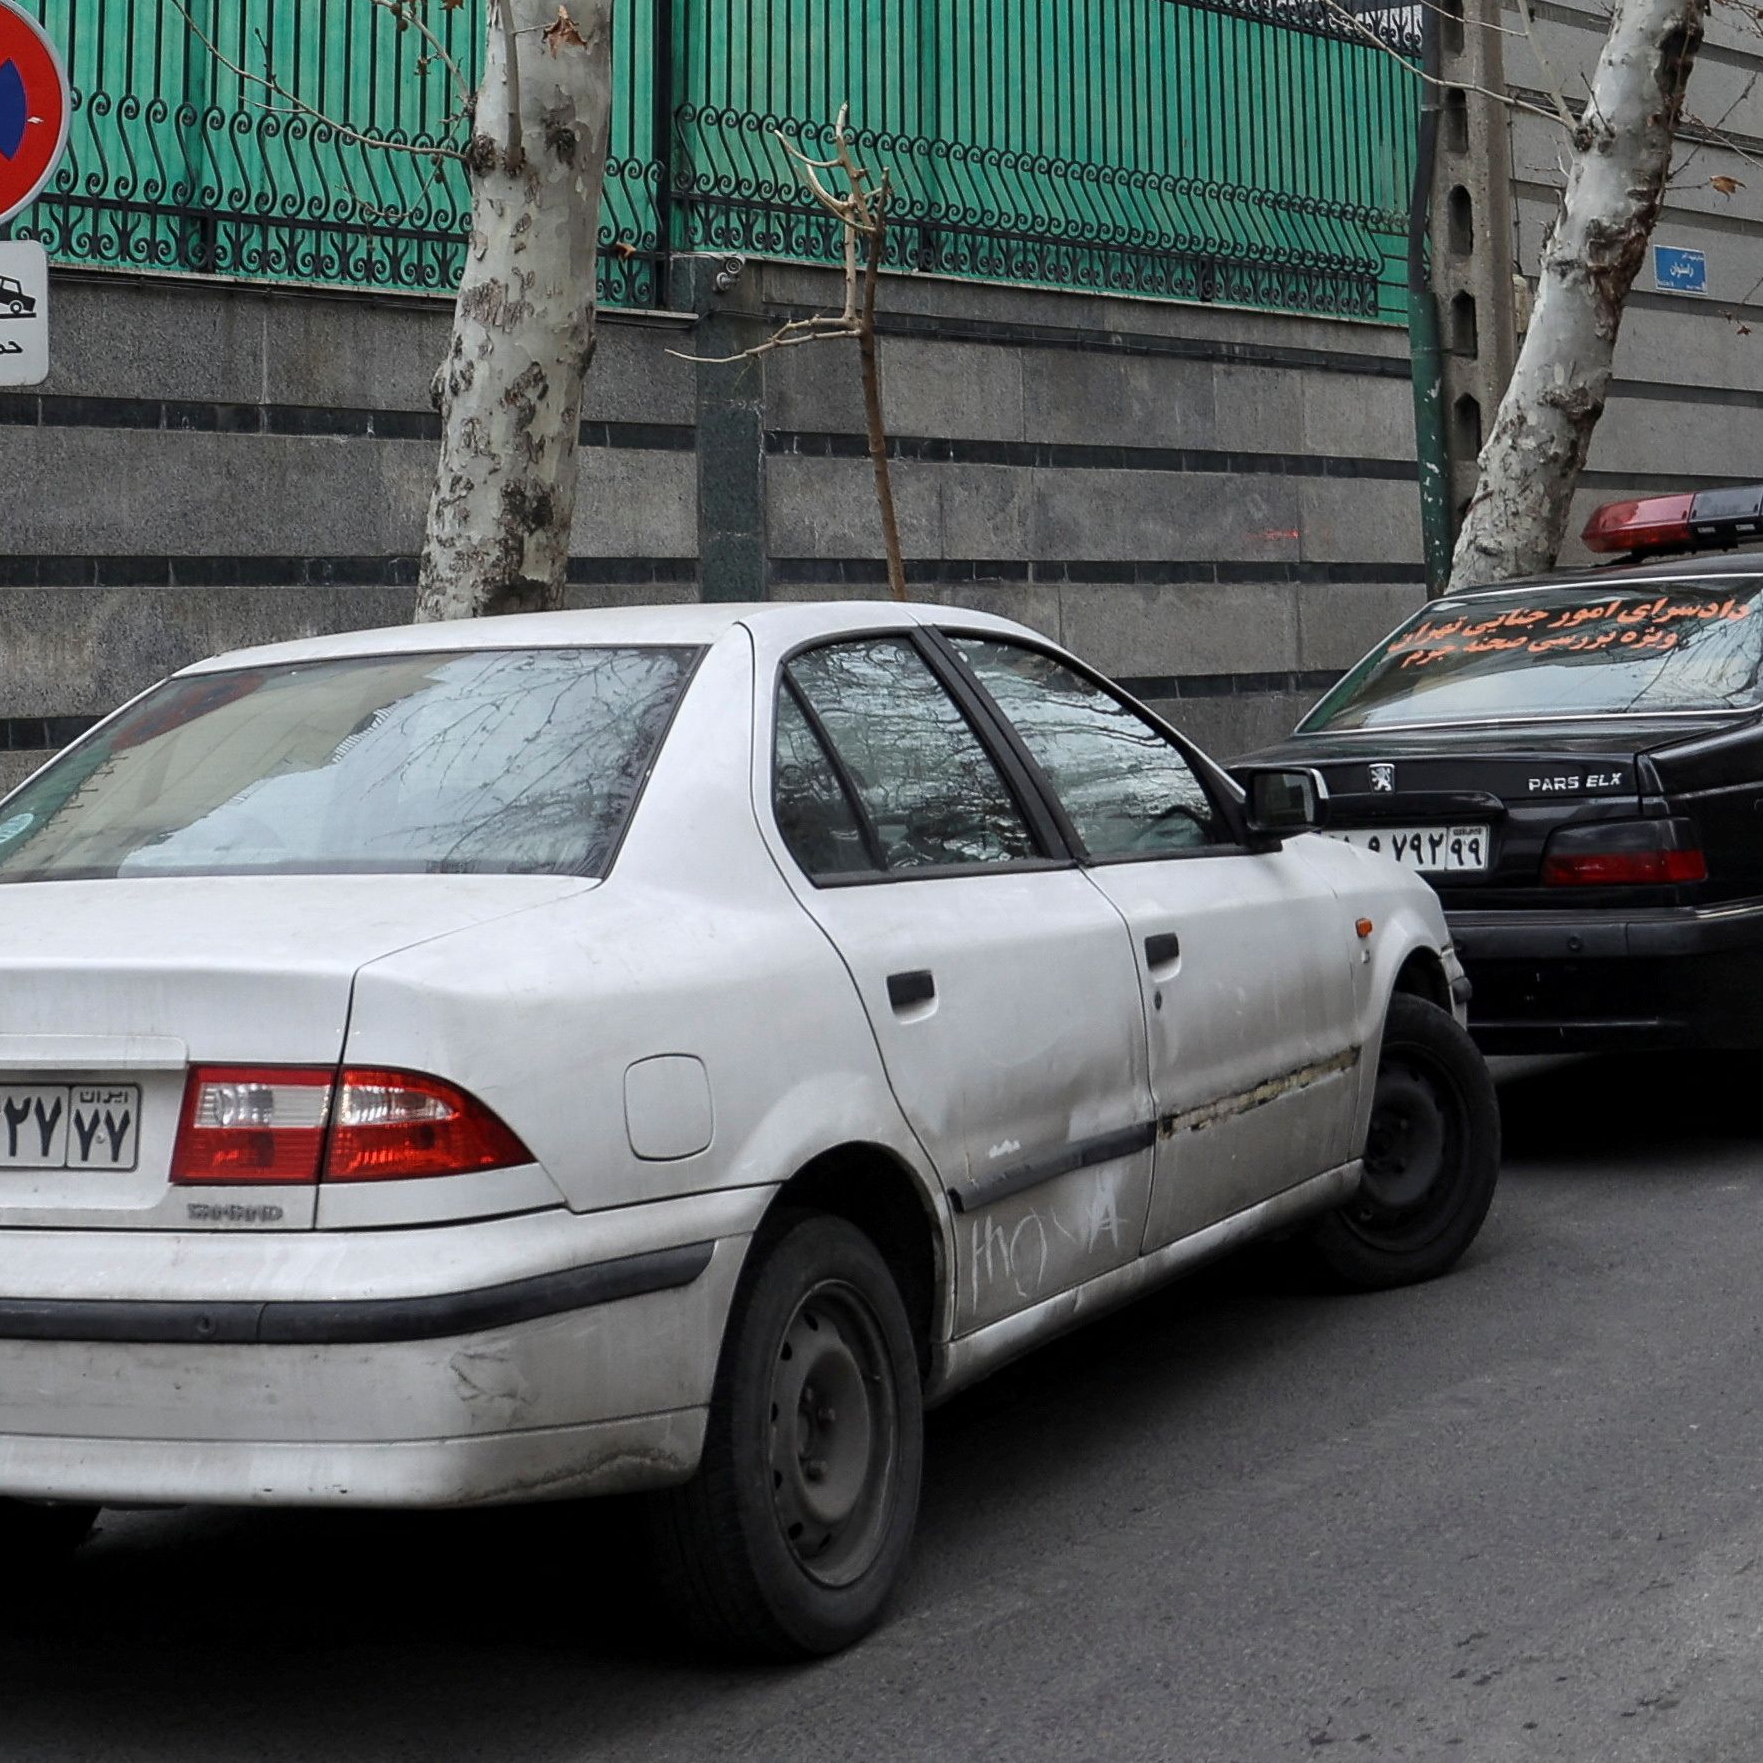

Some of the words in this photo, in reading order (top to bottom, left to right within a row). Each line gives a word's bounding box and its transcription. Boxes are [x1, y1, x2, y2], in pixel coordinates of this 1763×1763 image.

[1462, 607, 1550, 637] جنایی
[1548, 600, 1621, 628] امور
[1617, 596, 1752, 623] دادسرای
[1462, 636, 1528, 653] صحنه
[1528, 628, 1617, 652] بررسی
[1620, 628, 1679, 649] ویژه
[1399, 644, 1456, 669] جرم
[1528, 776, 1580, 791] PARS
[1585, 772, 1622, 788] ELX
[1392, 833, 1445, 866] ۷۹۲
[1450, 837, 1484, 867] ۹۹
[79, 1090, 130, 1104] ایران
[74, 1109, 131, 1163] ۷۷
